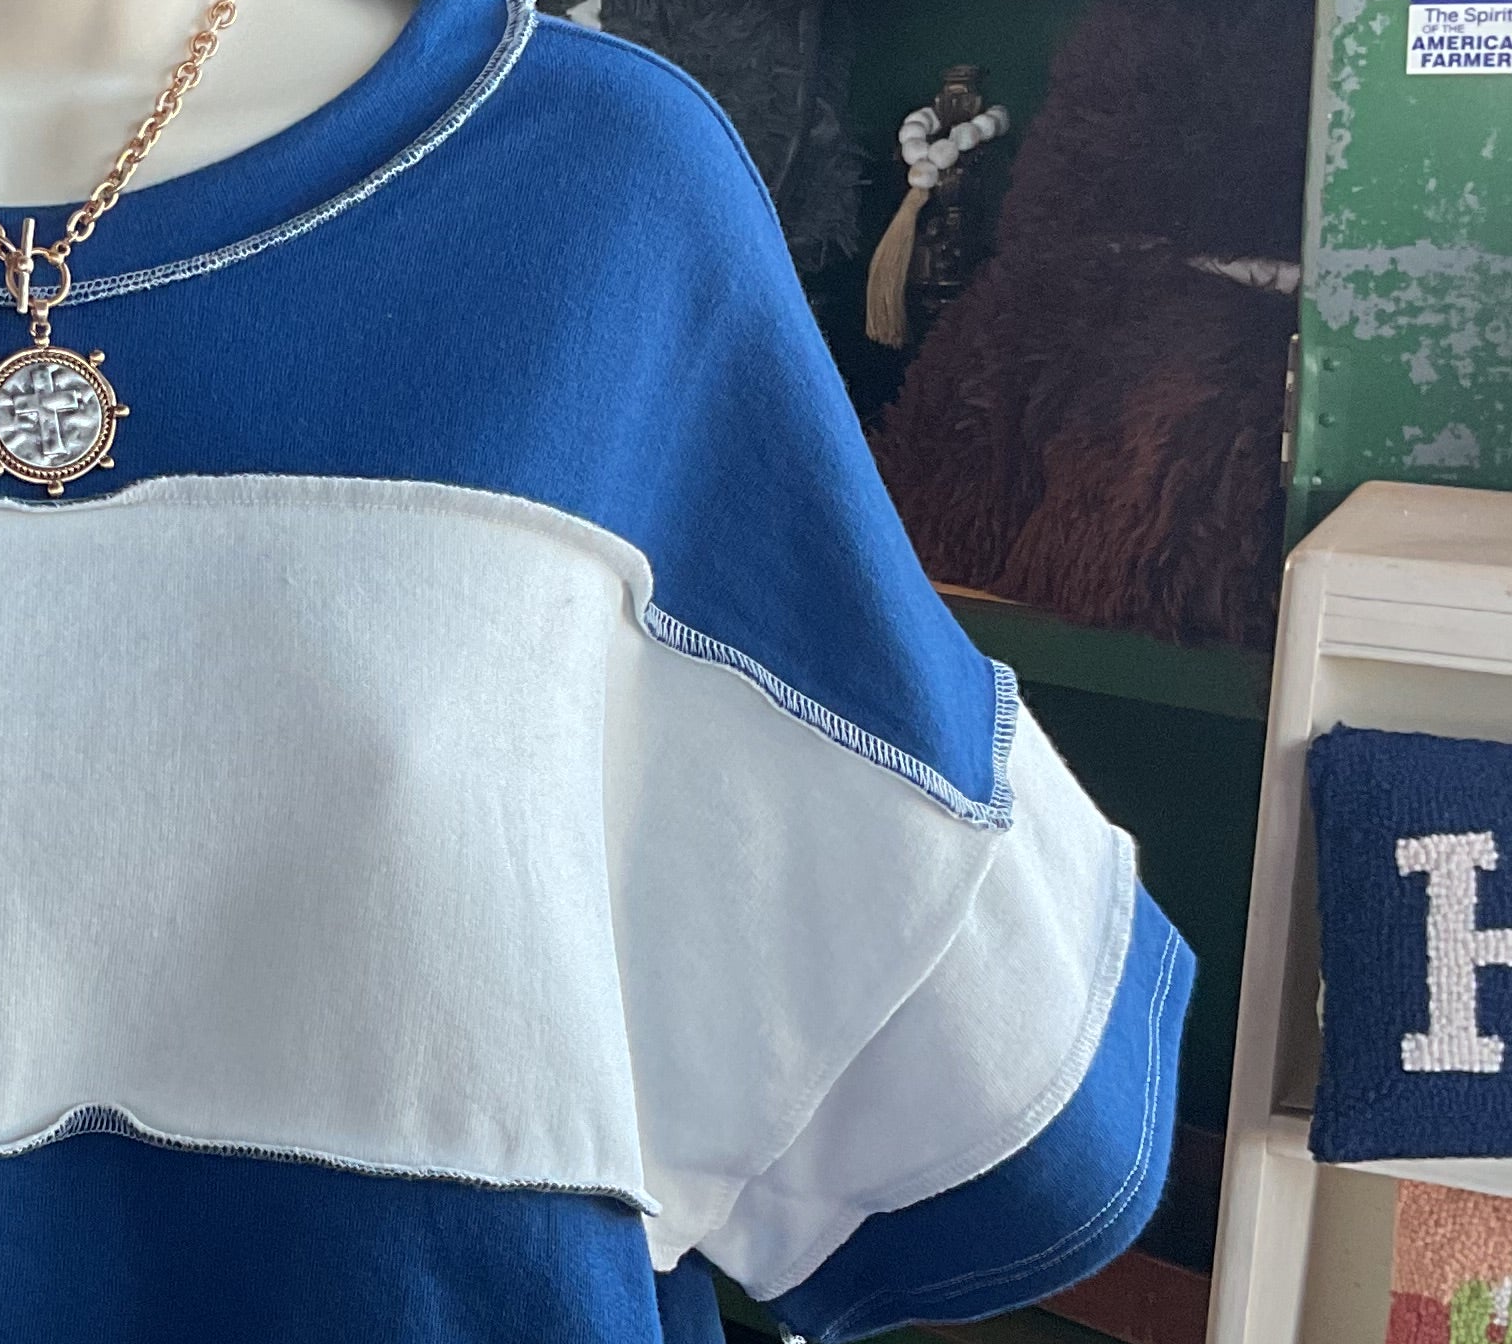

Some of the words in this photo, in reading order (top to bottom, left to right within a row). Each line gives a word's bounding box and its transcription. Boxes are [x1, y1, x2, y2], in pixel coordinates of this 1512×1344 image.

[1424, 8, 1459, 23] The
[1464, 6, 1512, 26] Spirit
[1422, 24, 1438, 34] OF
[1442, 24, 1465, 33] THE
[1412, 35, 1512, 50] AMERICA
[1421, 52, 1512, 68] FARMER
